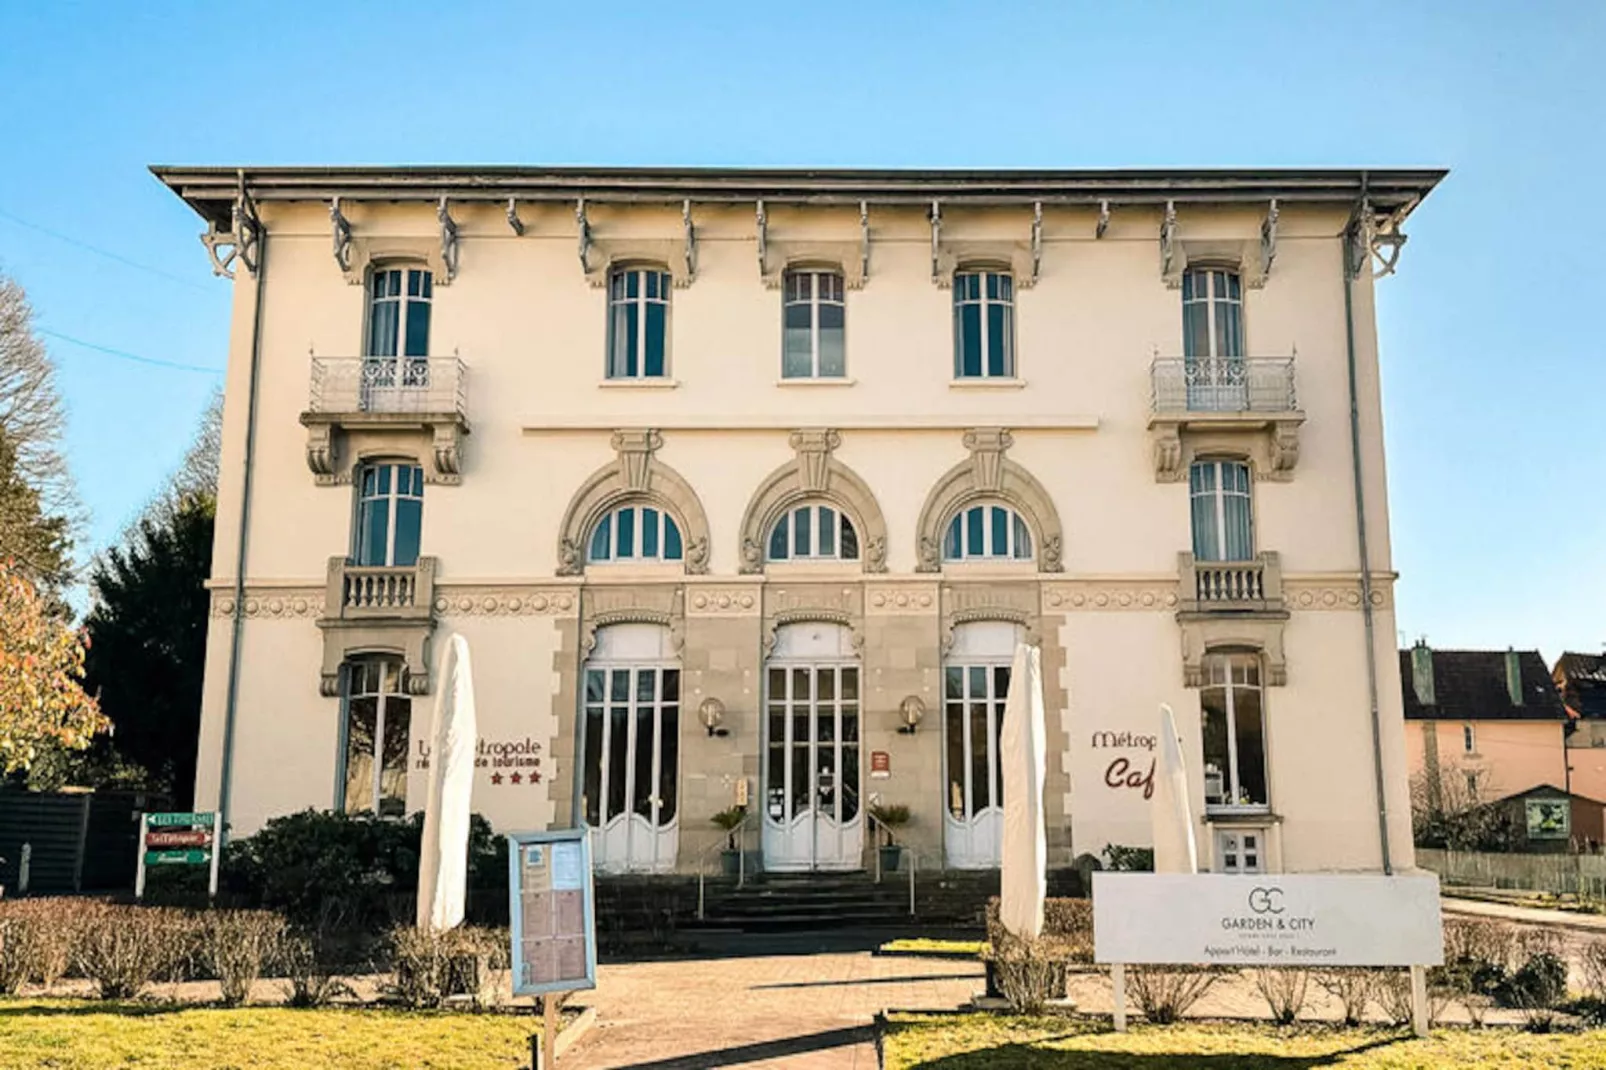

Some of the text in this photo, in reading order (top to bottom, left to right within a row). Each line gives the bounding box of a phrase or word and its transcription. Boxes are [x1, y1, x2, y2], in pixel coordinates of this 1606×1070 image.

[475, 737, 542, 759] tropole
[1091, 731, 1157, 751] Métrop
[492, 756, 541, 768] tourisme
[1105, 757, 1156, 800] Caf
[1221, 917, 1316, 930] GARDEN & CITY
[1268, 945, 1282, 957] Bar
